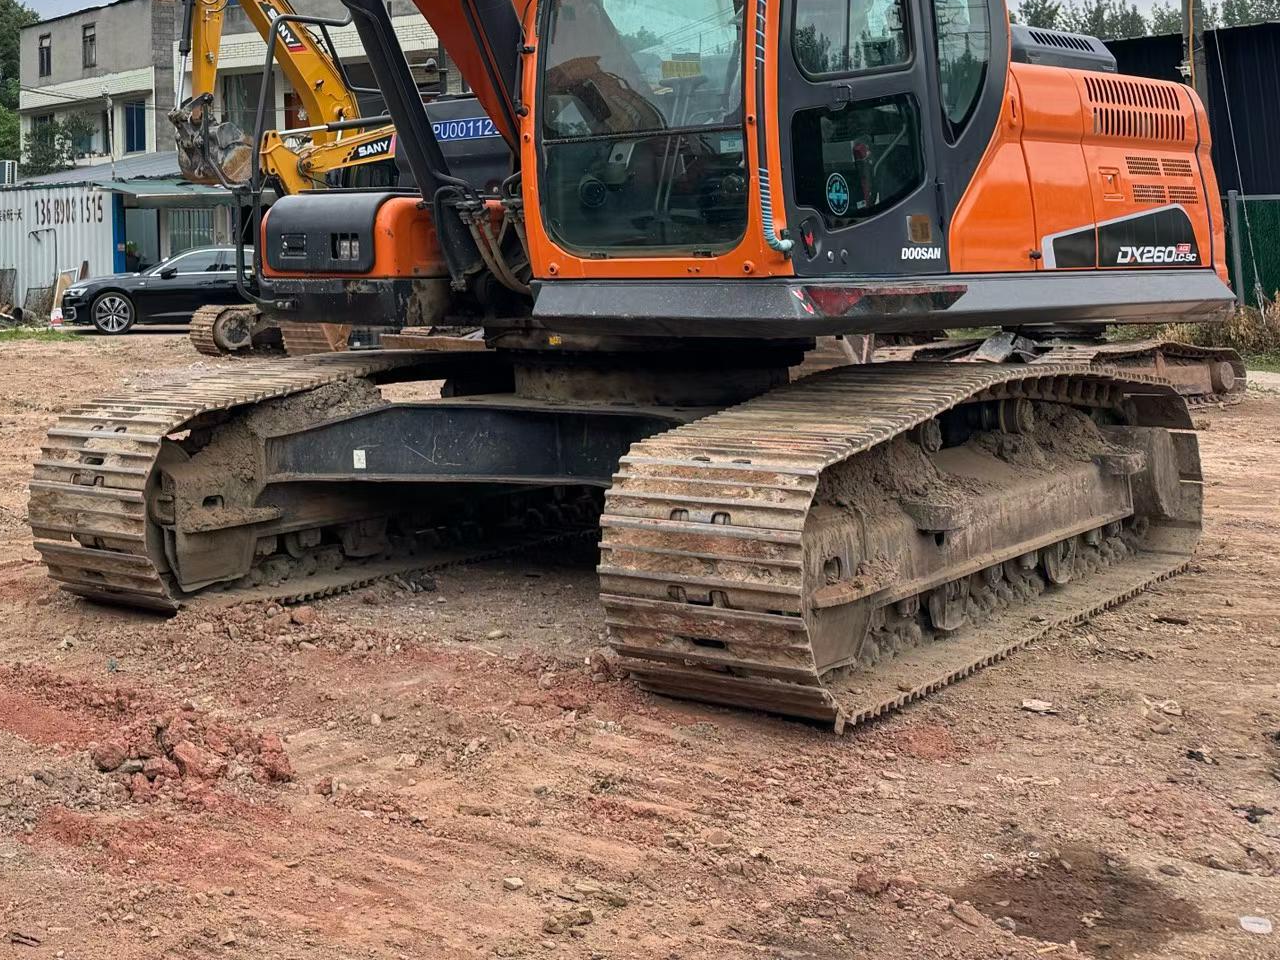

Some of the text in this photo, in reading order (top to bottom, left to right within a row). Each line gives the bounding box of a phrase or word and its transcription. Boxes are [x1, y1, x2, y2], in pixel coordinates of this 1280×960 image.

[358, 141, 388, 157] SANY
[35, 198, 51, 225] 136
[54, 196, 77, 225] 8908
[80, 194, 103, 223] 1515
[901, 247, 941, 260] DOOSAN
